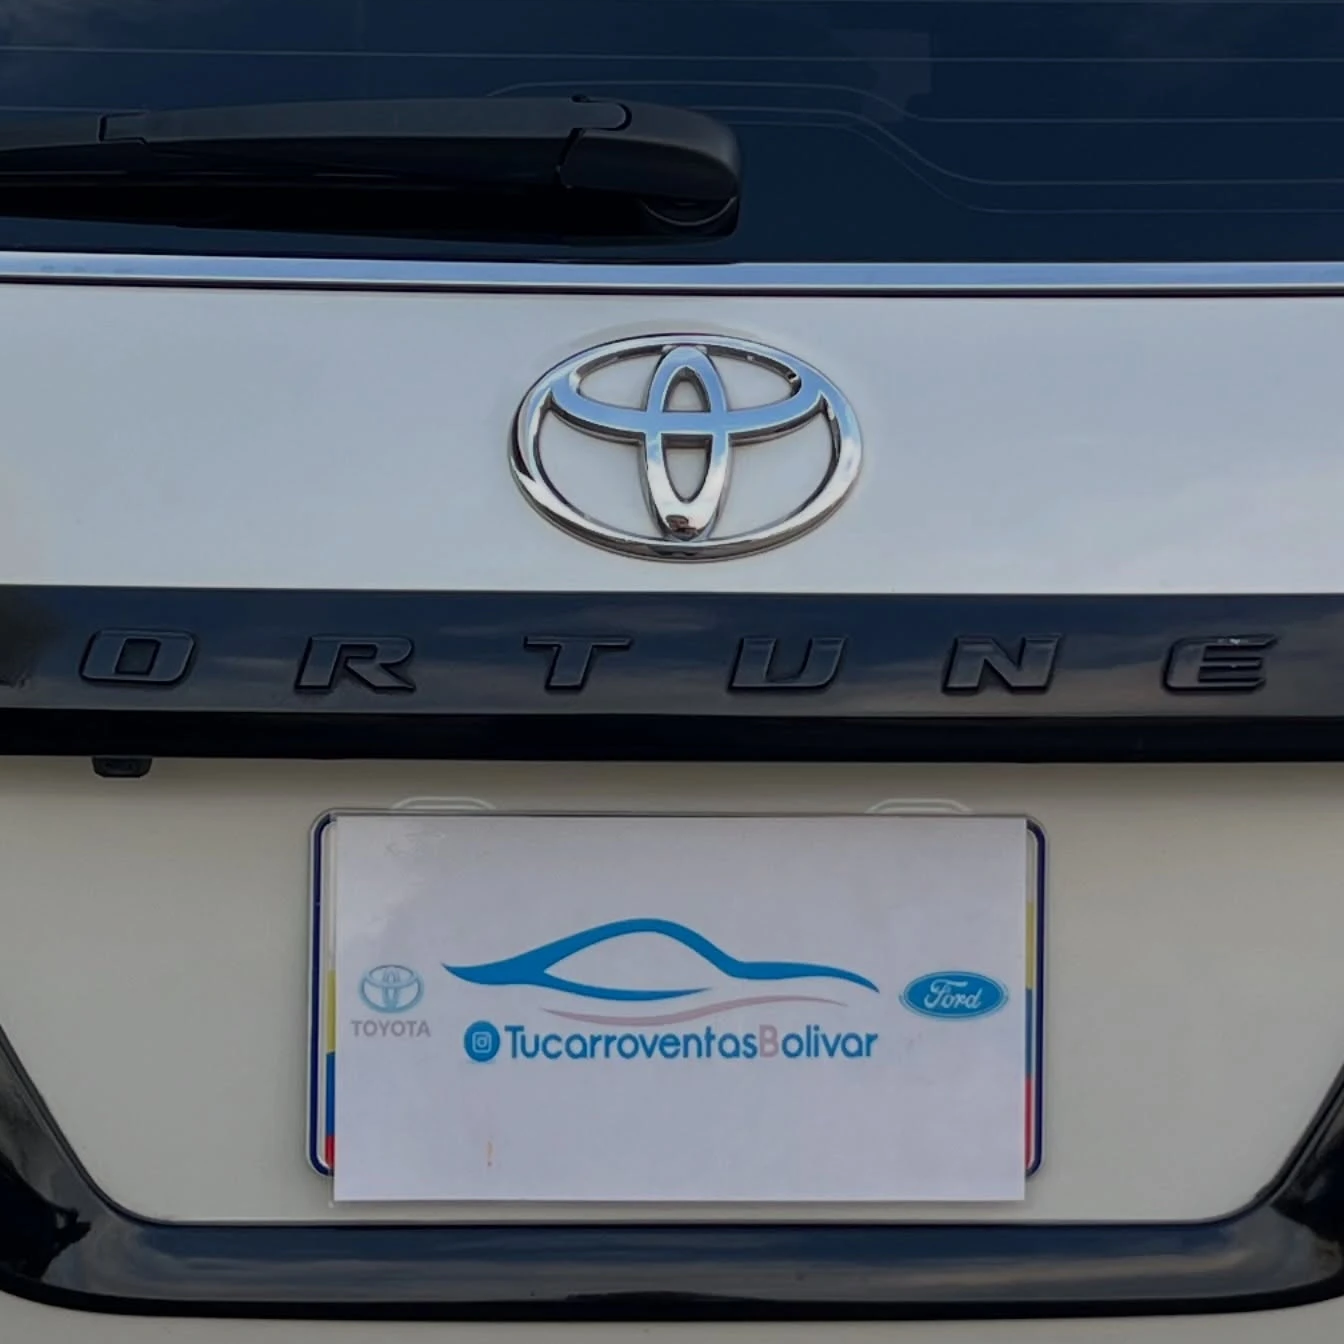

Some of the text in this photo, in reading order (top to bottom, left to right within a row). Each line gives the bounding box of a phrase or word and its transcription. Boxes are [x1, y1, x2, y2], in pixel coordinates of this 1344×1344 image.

[922, 977, 982, 1010] Ford
[350, 1019, 431, 1039] TOYOTA
[504, 1023, 880, 1059] TucarroventasBolivar
